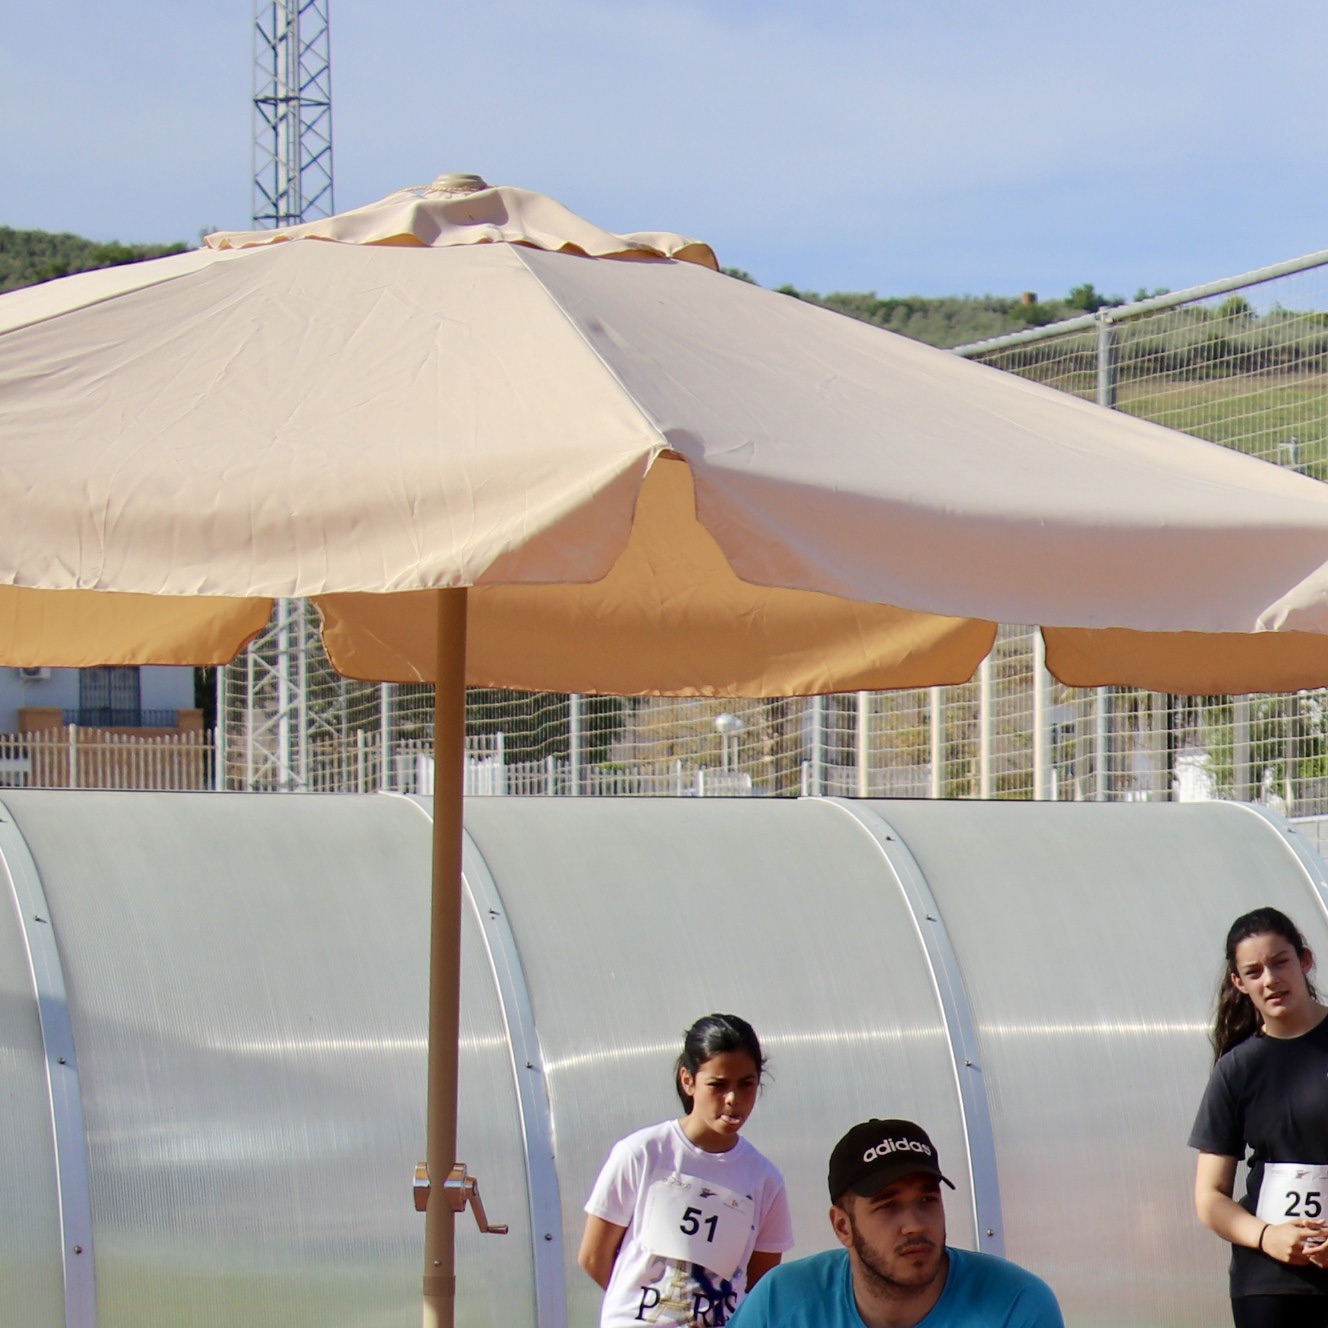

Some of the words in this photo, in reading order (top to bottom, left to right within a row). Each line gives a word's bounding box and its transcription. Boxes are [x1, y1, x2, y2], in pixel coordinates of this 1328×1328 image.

[862, 1137, 932, 1163] adidas
[1284, 1191, 1323, 1218] 25
[679, 1206, 719, 1243] 51
